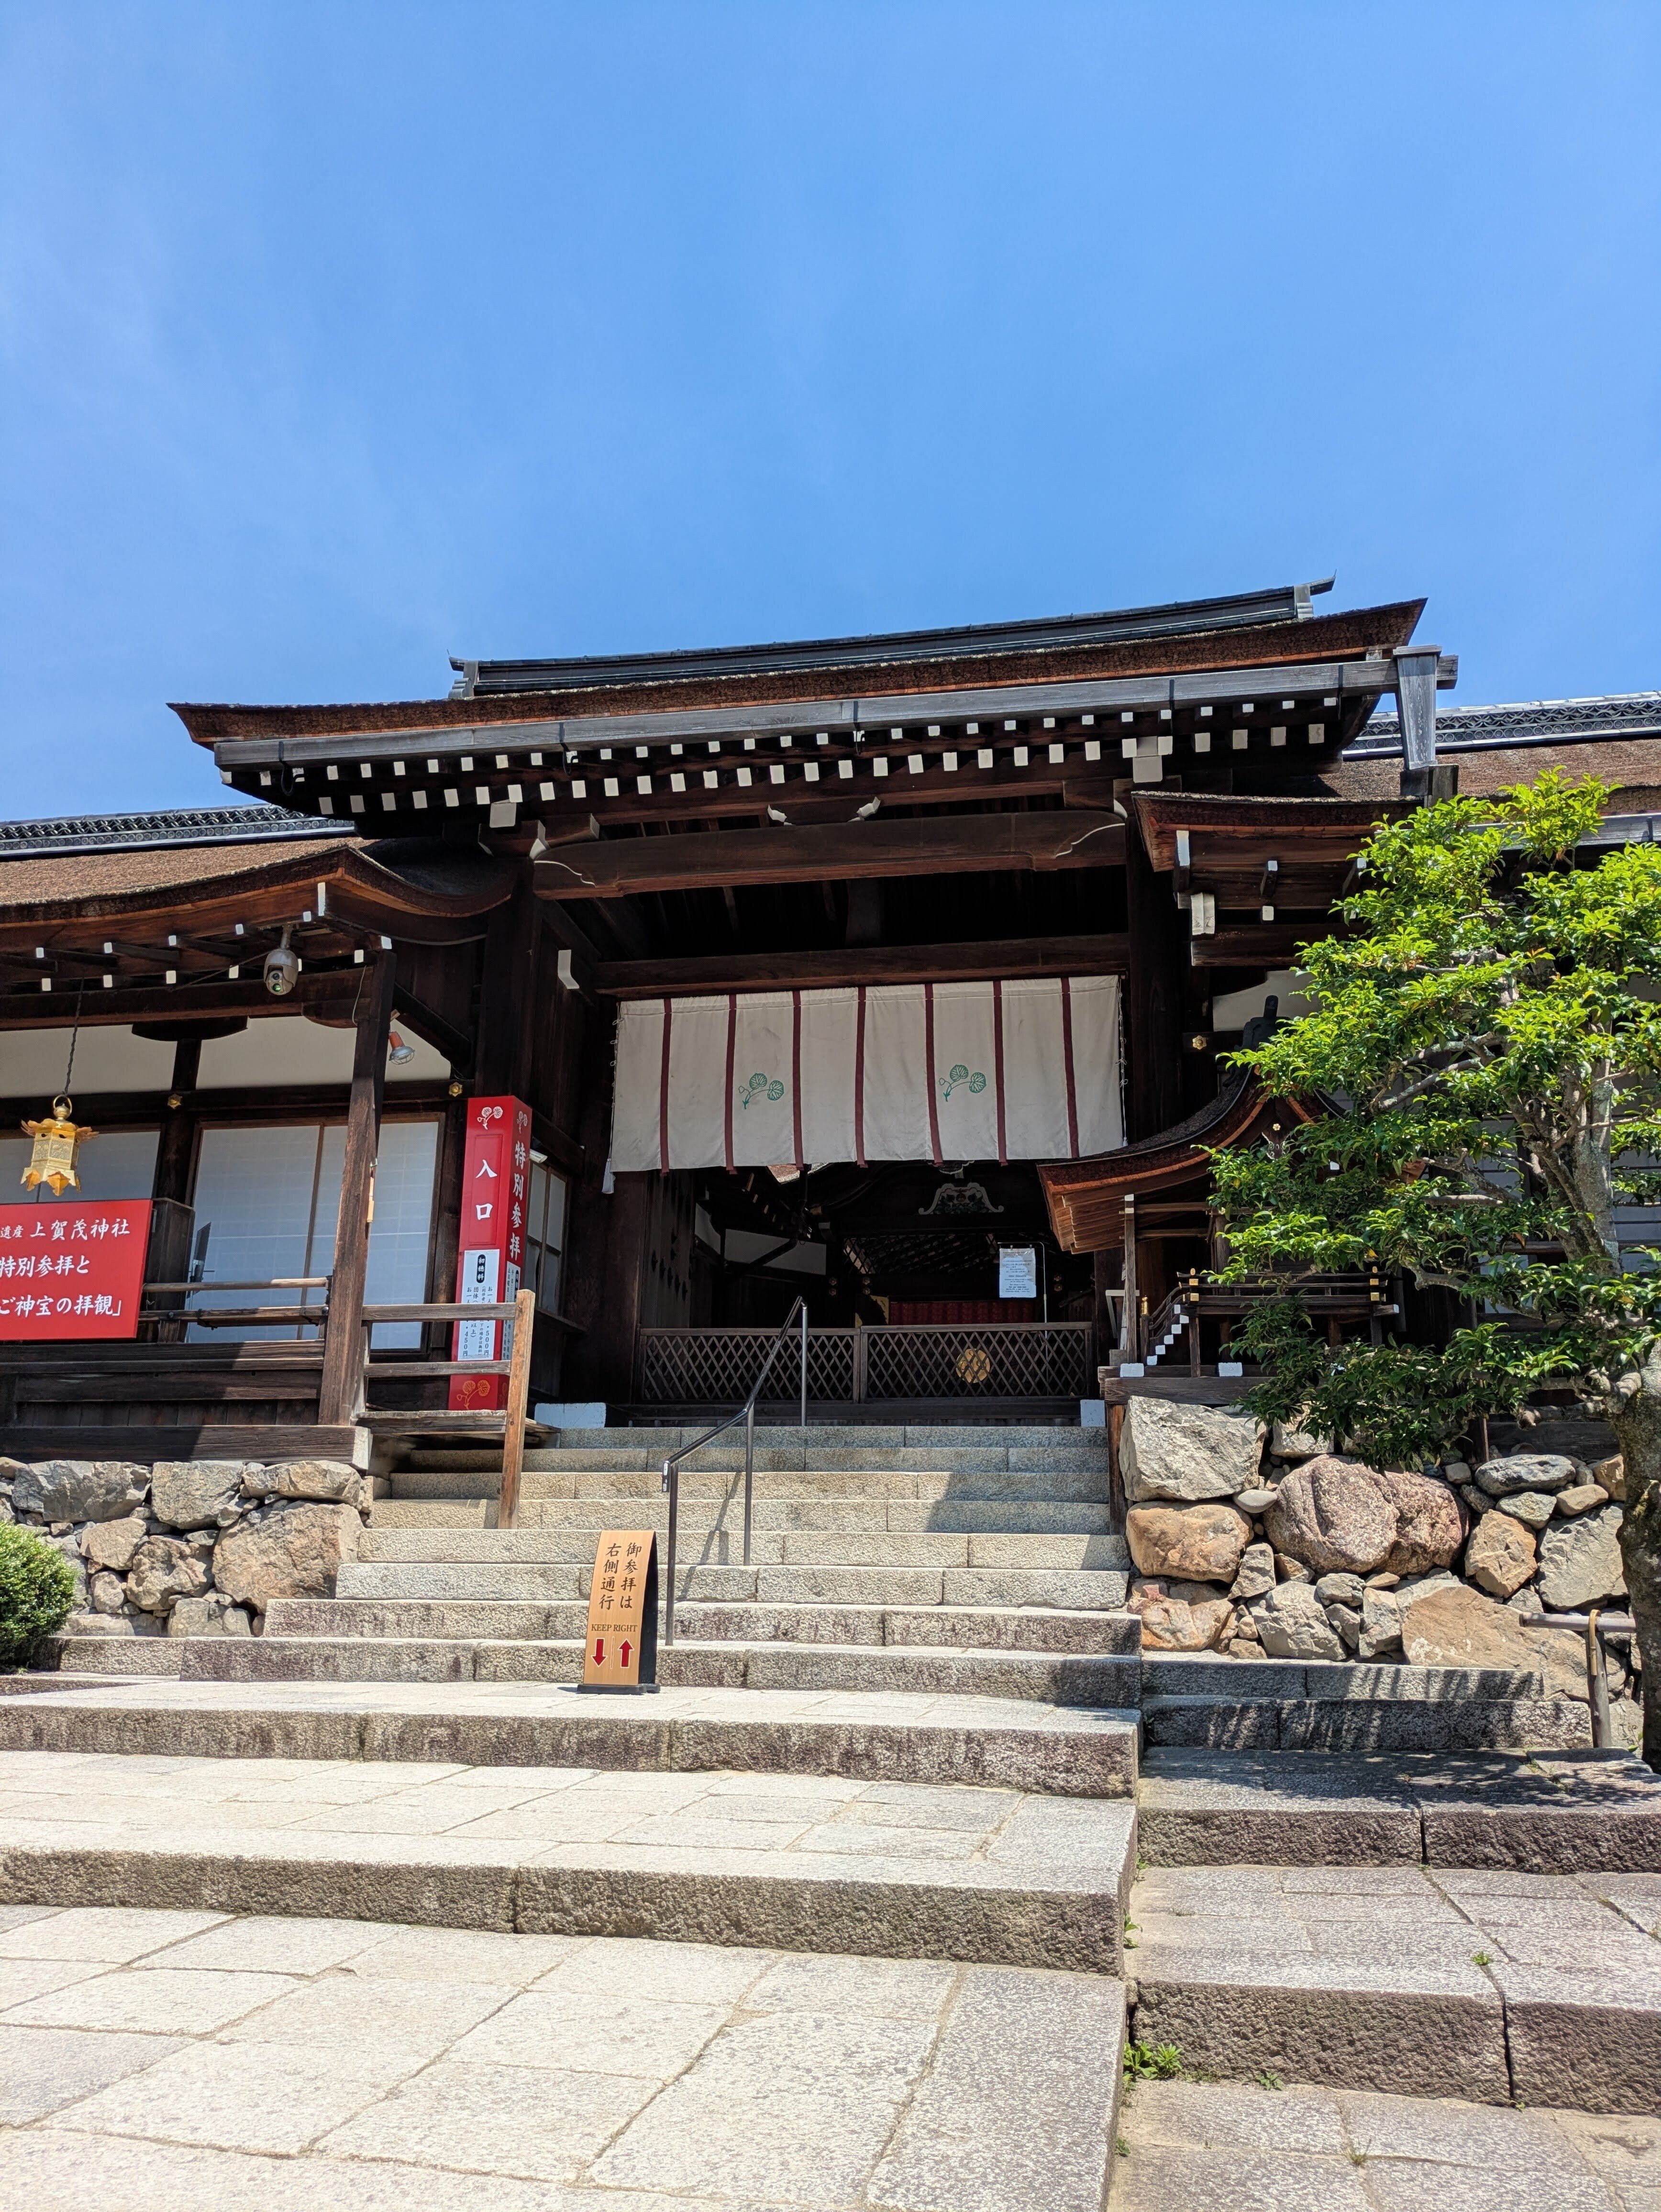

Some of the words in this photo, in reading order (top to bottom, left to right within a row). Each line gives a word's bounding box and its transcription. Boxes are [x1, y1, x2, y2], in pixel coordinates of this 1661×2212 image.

[476, 1159, 498, 1220] 入口
[509, 1140, 526, 1261] 特別参拝
[30, 1218, 130, 1240] 上賀茂神社
[0, 1255, 90, 1278] 特別参拝と
[598, 1543, 622, 1610] 右側通行
[620, 1542, 642, 1609] 御参拝は
[591, 1624, 612, 1632] KEEP
[613, 1624, 638, 1632] RIGHT
